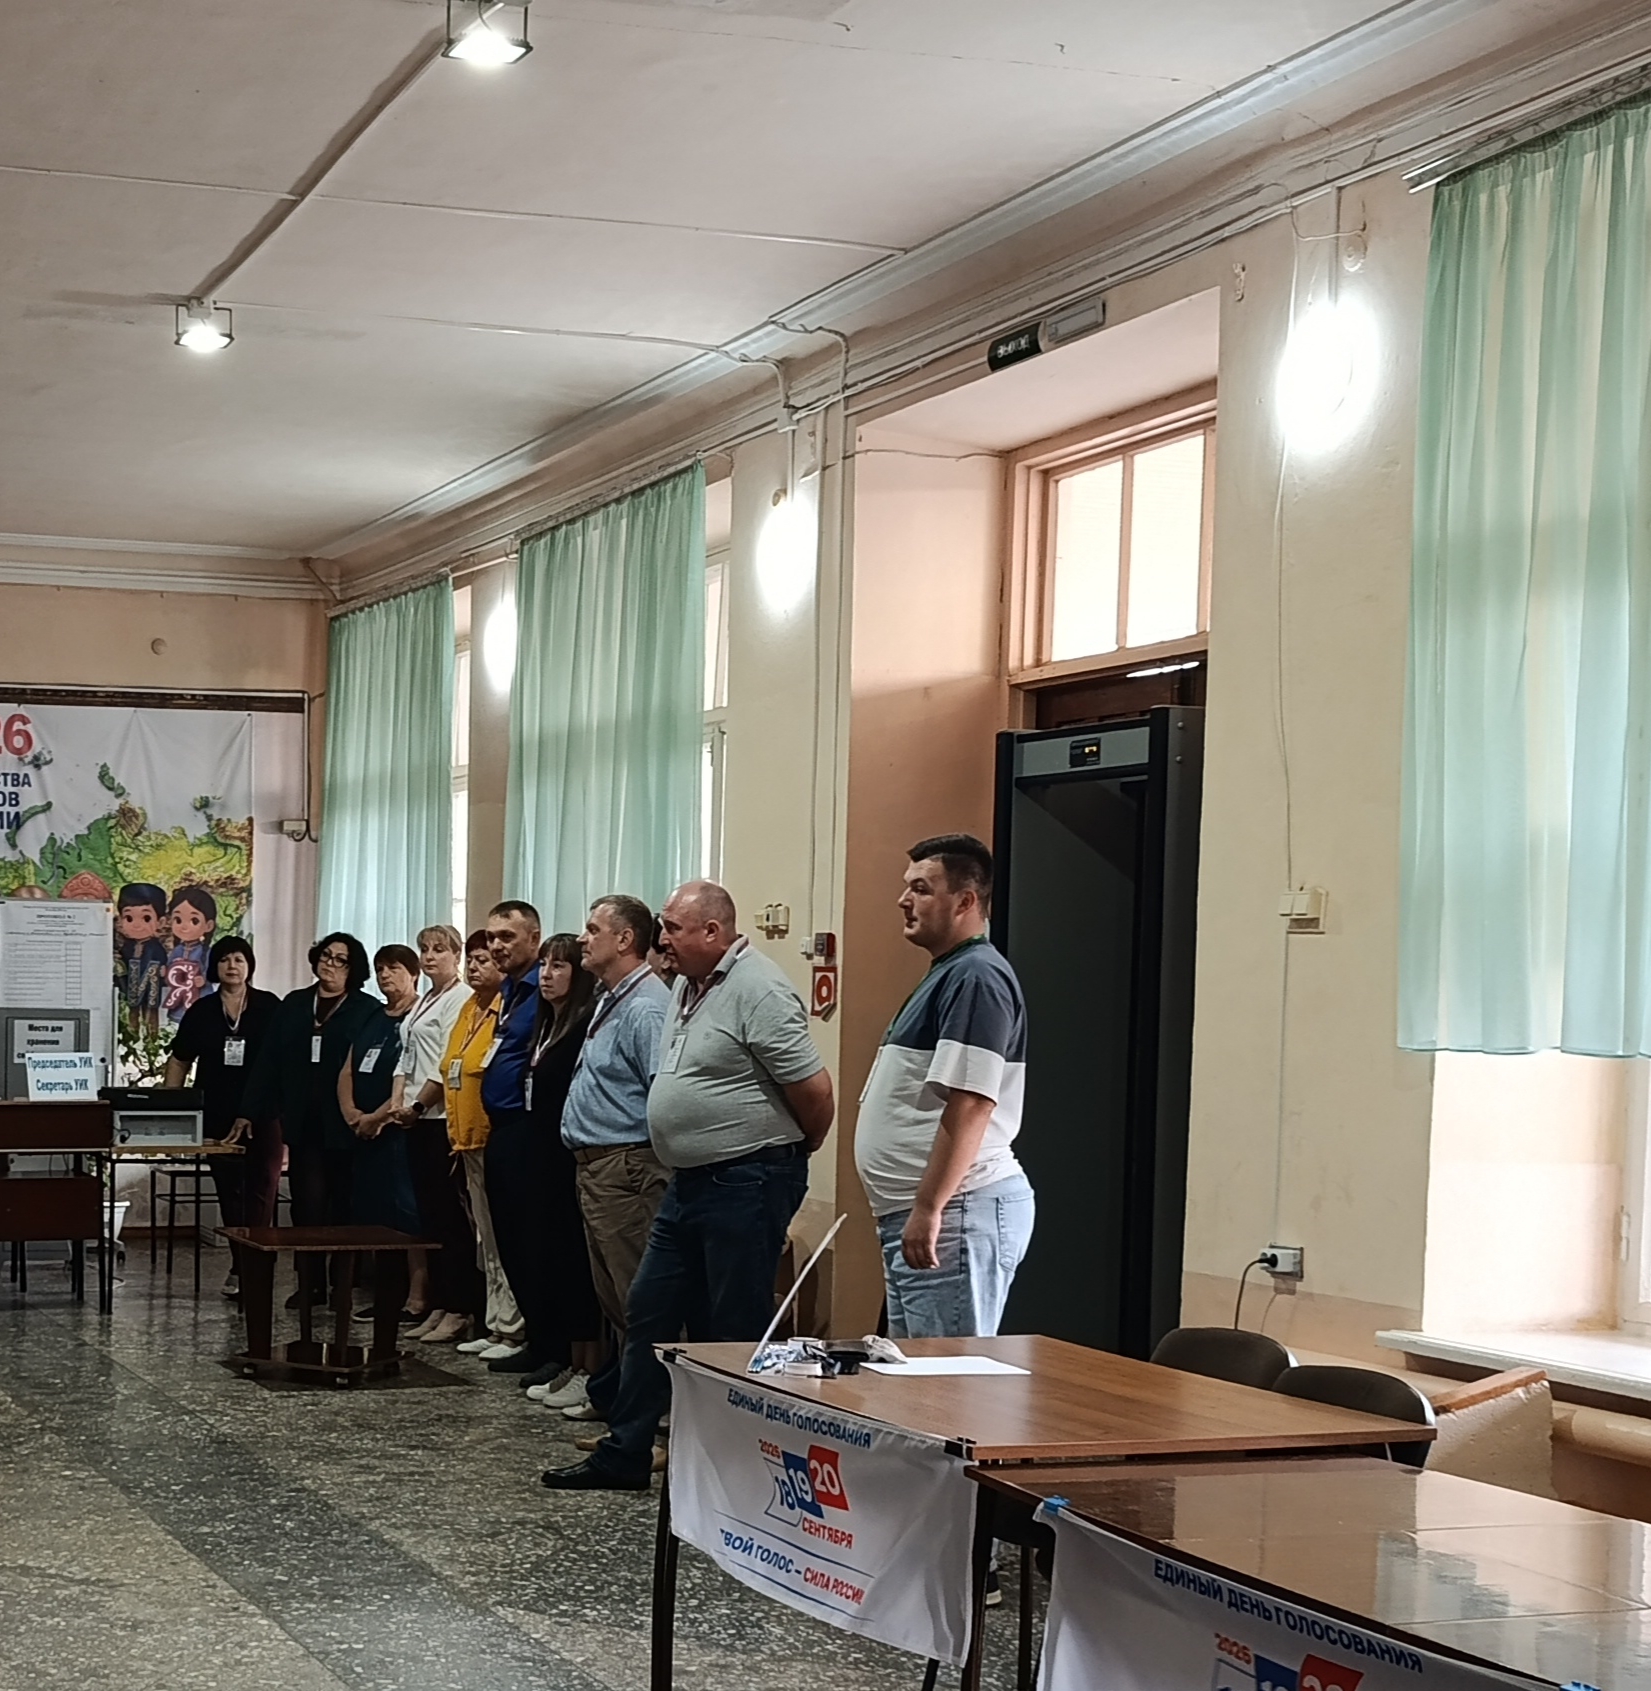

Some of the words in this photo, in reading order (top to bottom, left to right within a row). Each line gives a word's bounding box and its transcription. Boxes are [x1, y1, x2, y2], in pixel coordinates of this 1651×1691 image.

[28, 1057, 77, 1071] Председатель
[78, 1056, 93, 1068] УИК
[36, 1079, 73, 1094] Секретарь
[74, 1078, 89, 1091] УИК
[727, 1388, 764, 1416] ЕДИНЫЙ
[765, 1404, 792, 1425] ДЕНЬ
[792, 1412, 871, 1449] ГОЛОСОВАНИЯ
[775, 1476, 796, 1511] 18
[788, 1468, 813, 1503] 19
[809, 1459, 840, 1496] 20
[802, 1517, 853, 1549] СЕНТЯБРЯ
[755, 1545, 794, 1573] ГОЛОС
[803, 1567, 830, 1591] СИЛА
[1154, 1558, 1223, 1603] ЕДИНЫЙ
[1228, 1589, 1272, 1622] ДЕНЬ
[1276, 1607, 1423, 1673] ГОЛОСОВАНИЯ
